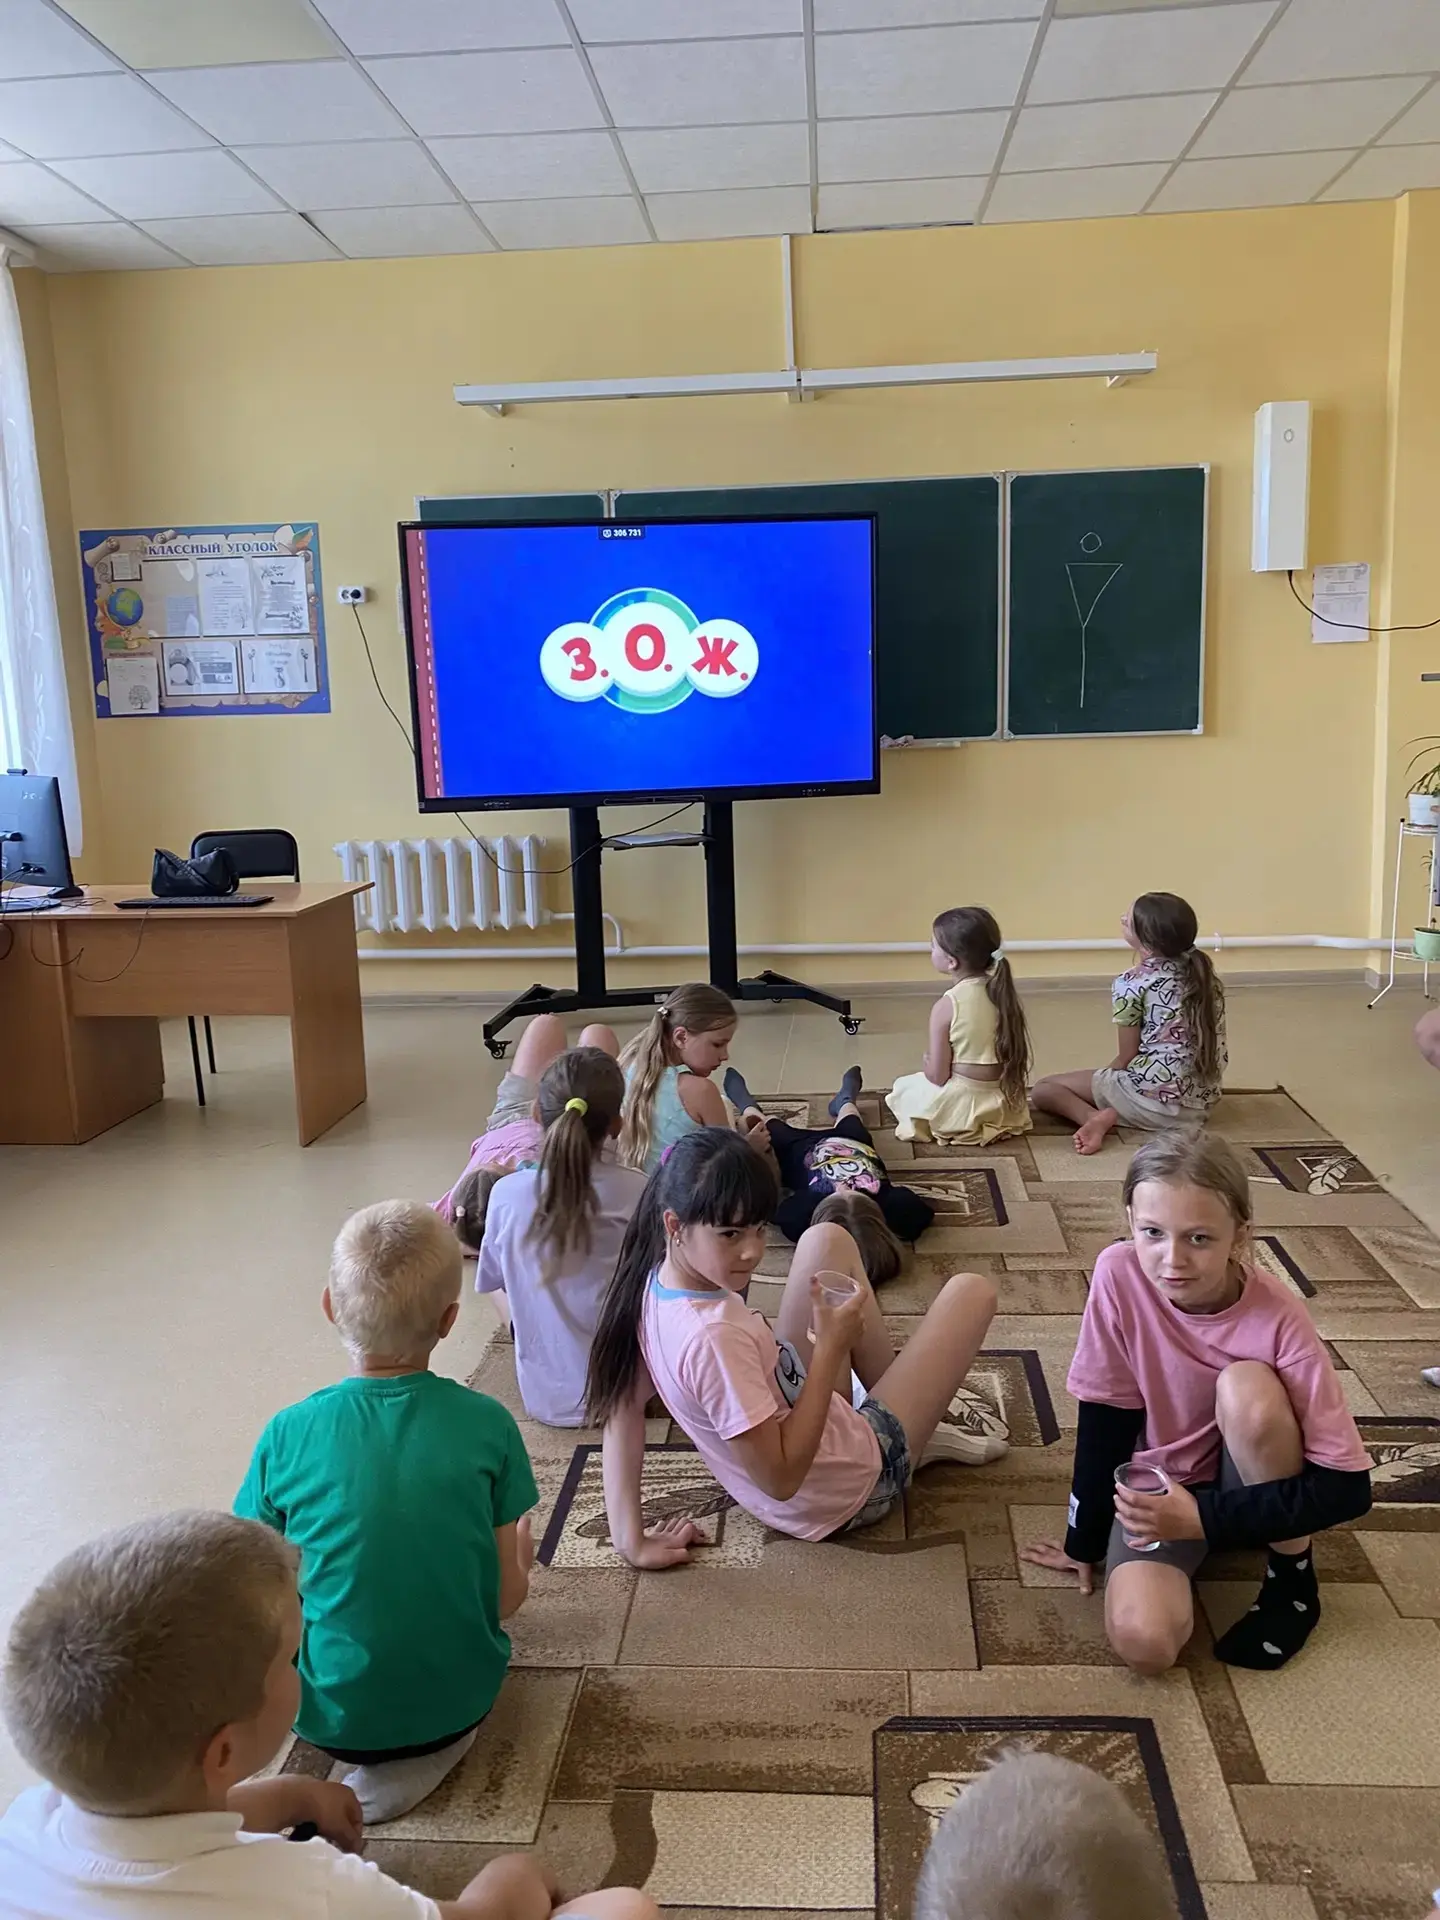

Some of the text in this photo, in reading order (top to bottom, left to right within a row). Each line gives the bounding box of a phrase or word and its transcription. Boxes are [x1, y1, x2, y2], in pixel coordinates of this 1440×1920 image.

[628, 529, 641, 537] 731
[148, 541, 278, 555] КЛАССНЫЙ УГОЛОК
